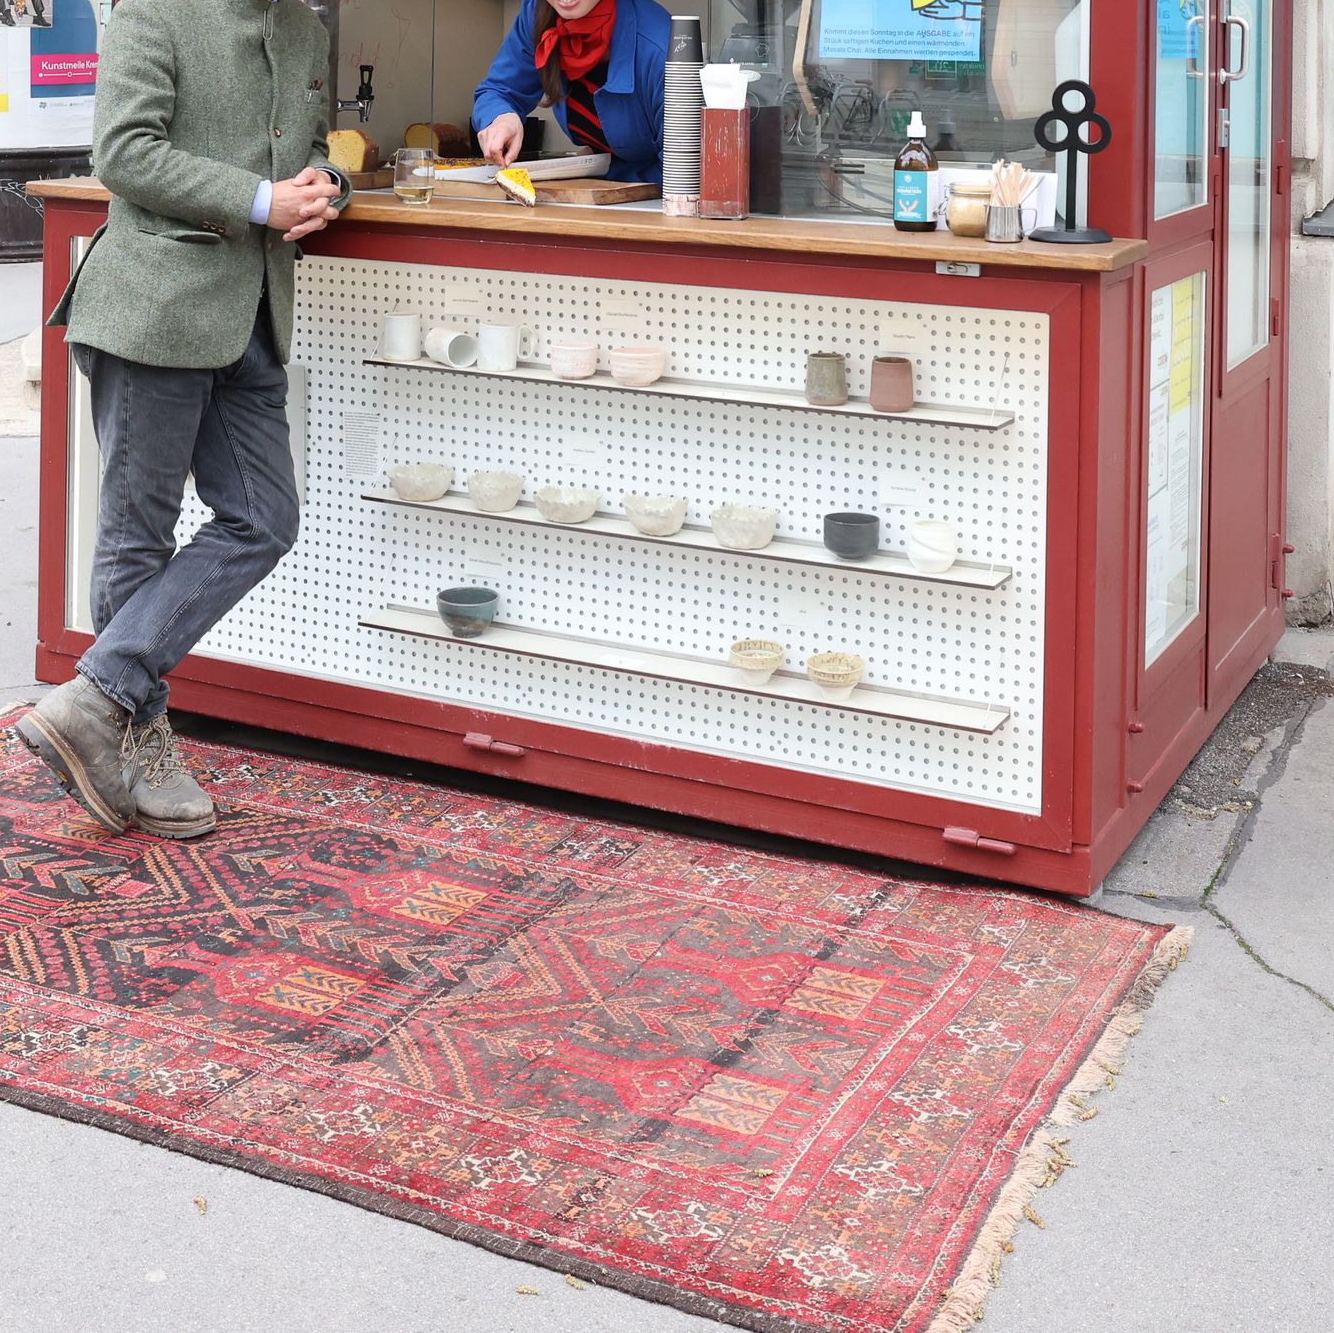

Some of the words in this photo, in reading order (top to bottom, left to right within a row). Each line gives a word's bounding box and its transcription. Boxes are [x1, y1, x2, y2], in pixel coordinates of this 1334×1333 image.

[869, 29, 897, 37] Sonntag
[916, 30, 952, 38] AUSGABE
[926, 39, 965, 47] wärmenden
[913, 48, 938, 56] werden
[938, 49, 976, 57] gespendet.
[41, 61, 85, 70] Kunstmeile
